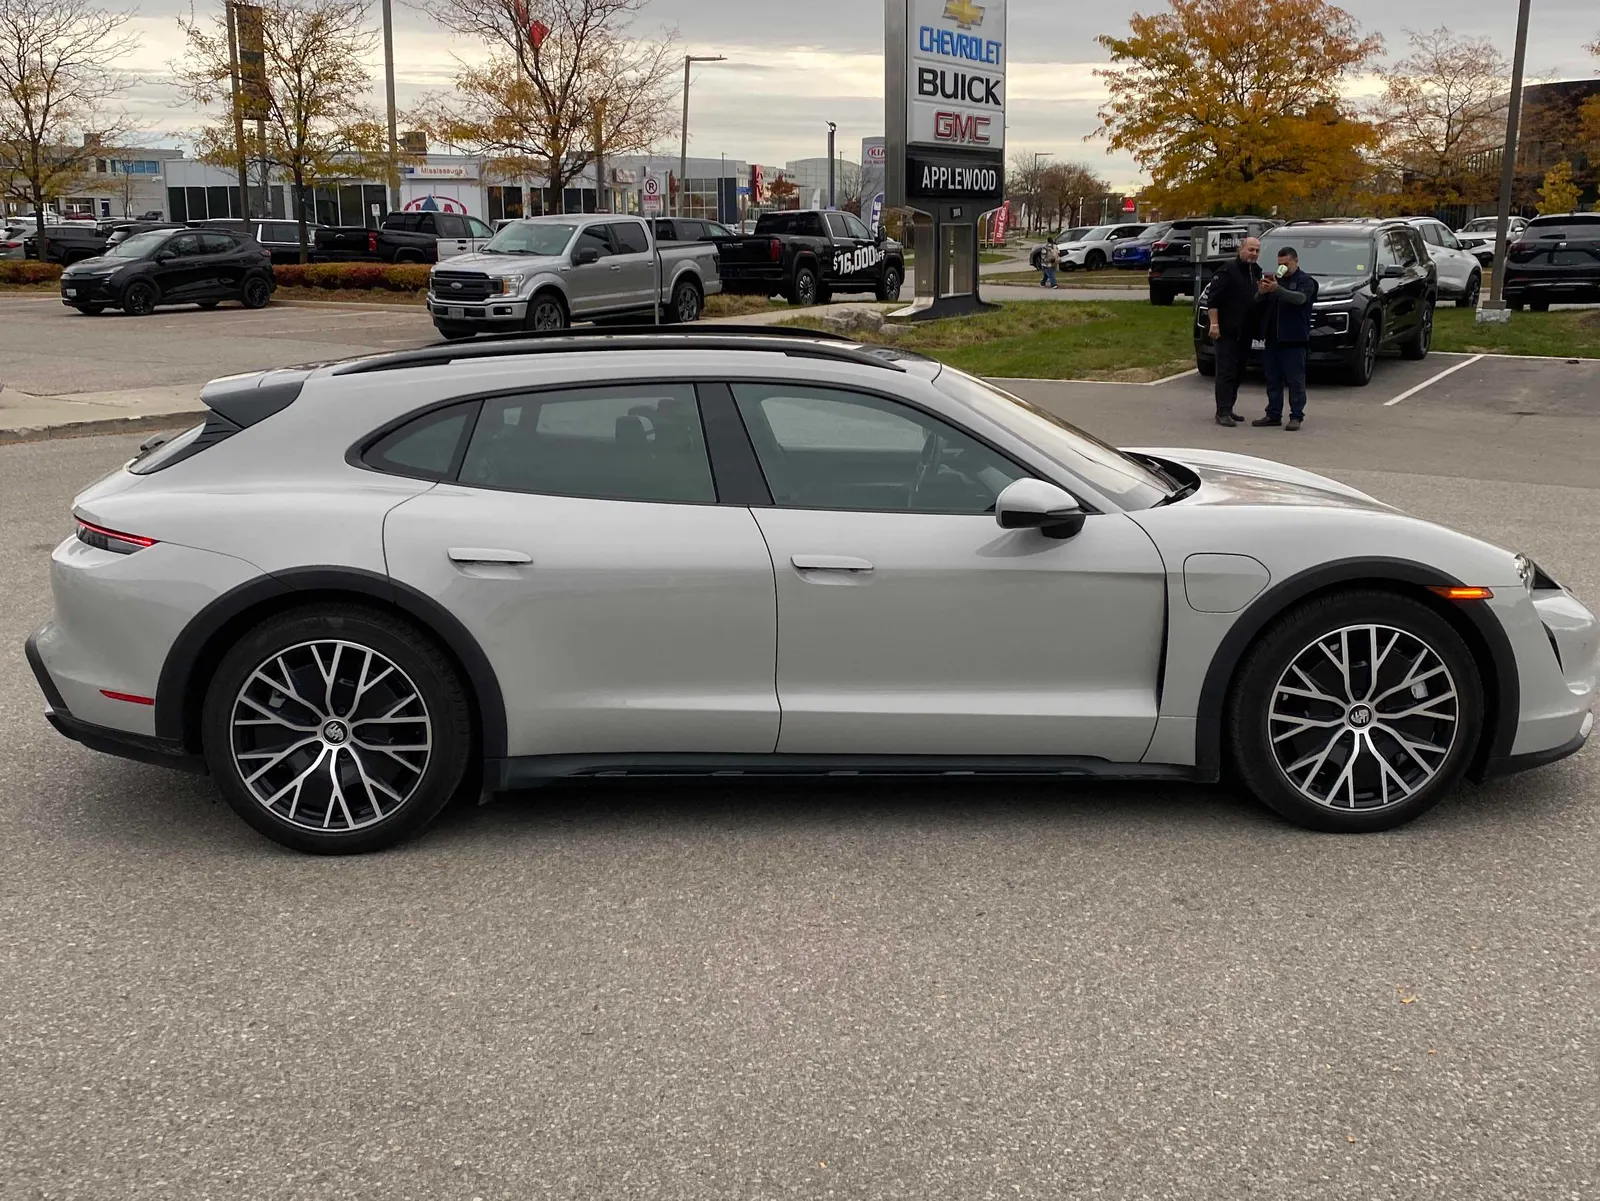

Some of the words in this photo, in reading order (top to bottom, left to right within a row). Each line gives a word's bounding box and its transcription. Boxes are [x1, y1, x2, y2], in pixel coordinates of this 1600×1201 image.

[919, 26, 1002, 65] CHEVROLET
[918, 67, 1002, 106] BUICK
[934, 109, 992, 143] GMC
[921, 165, 997, 191] APPLEWOOD
[996, 221, 1004, 238] Used
[833, 245, 876, 275] $16,000
[875, 249, 885, 262] OFF
